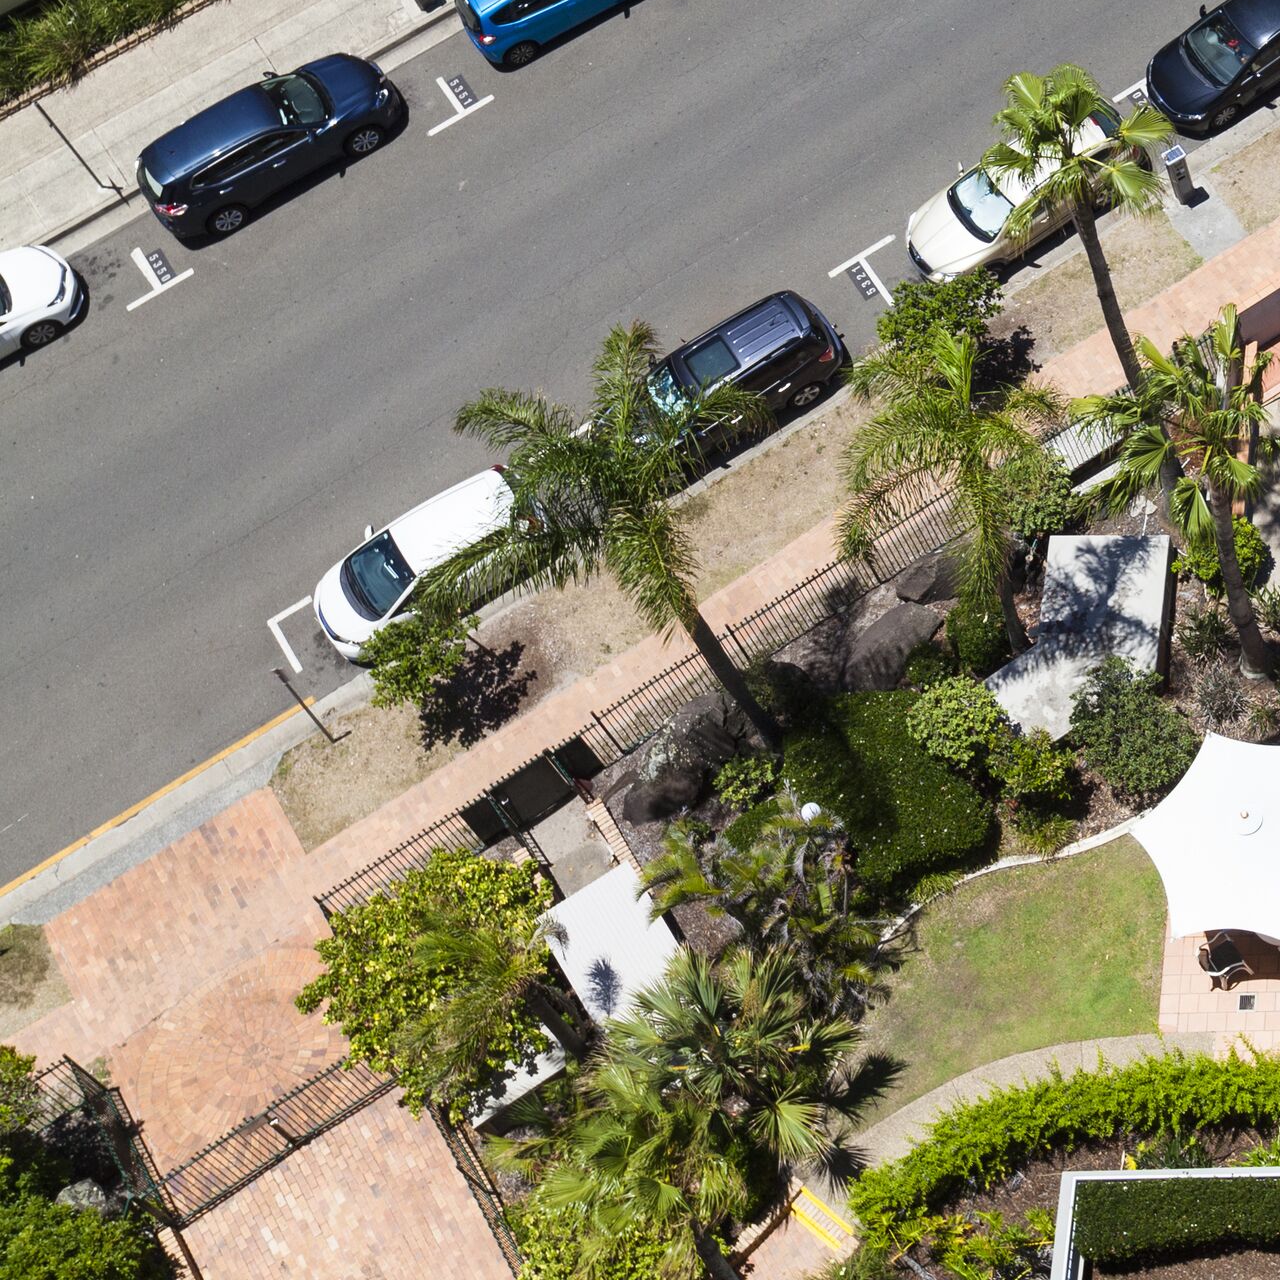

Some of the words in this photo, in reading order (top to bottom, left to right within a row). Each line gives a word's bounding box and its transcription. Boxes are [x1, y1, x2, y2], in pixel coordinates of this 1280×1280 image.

[449, 78, 473, 106] 5351
[148, 253, 171, 282] 5350
[851, 265, 876, 296] 5321
